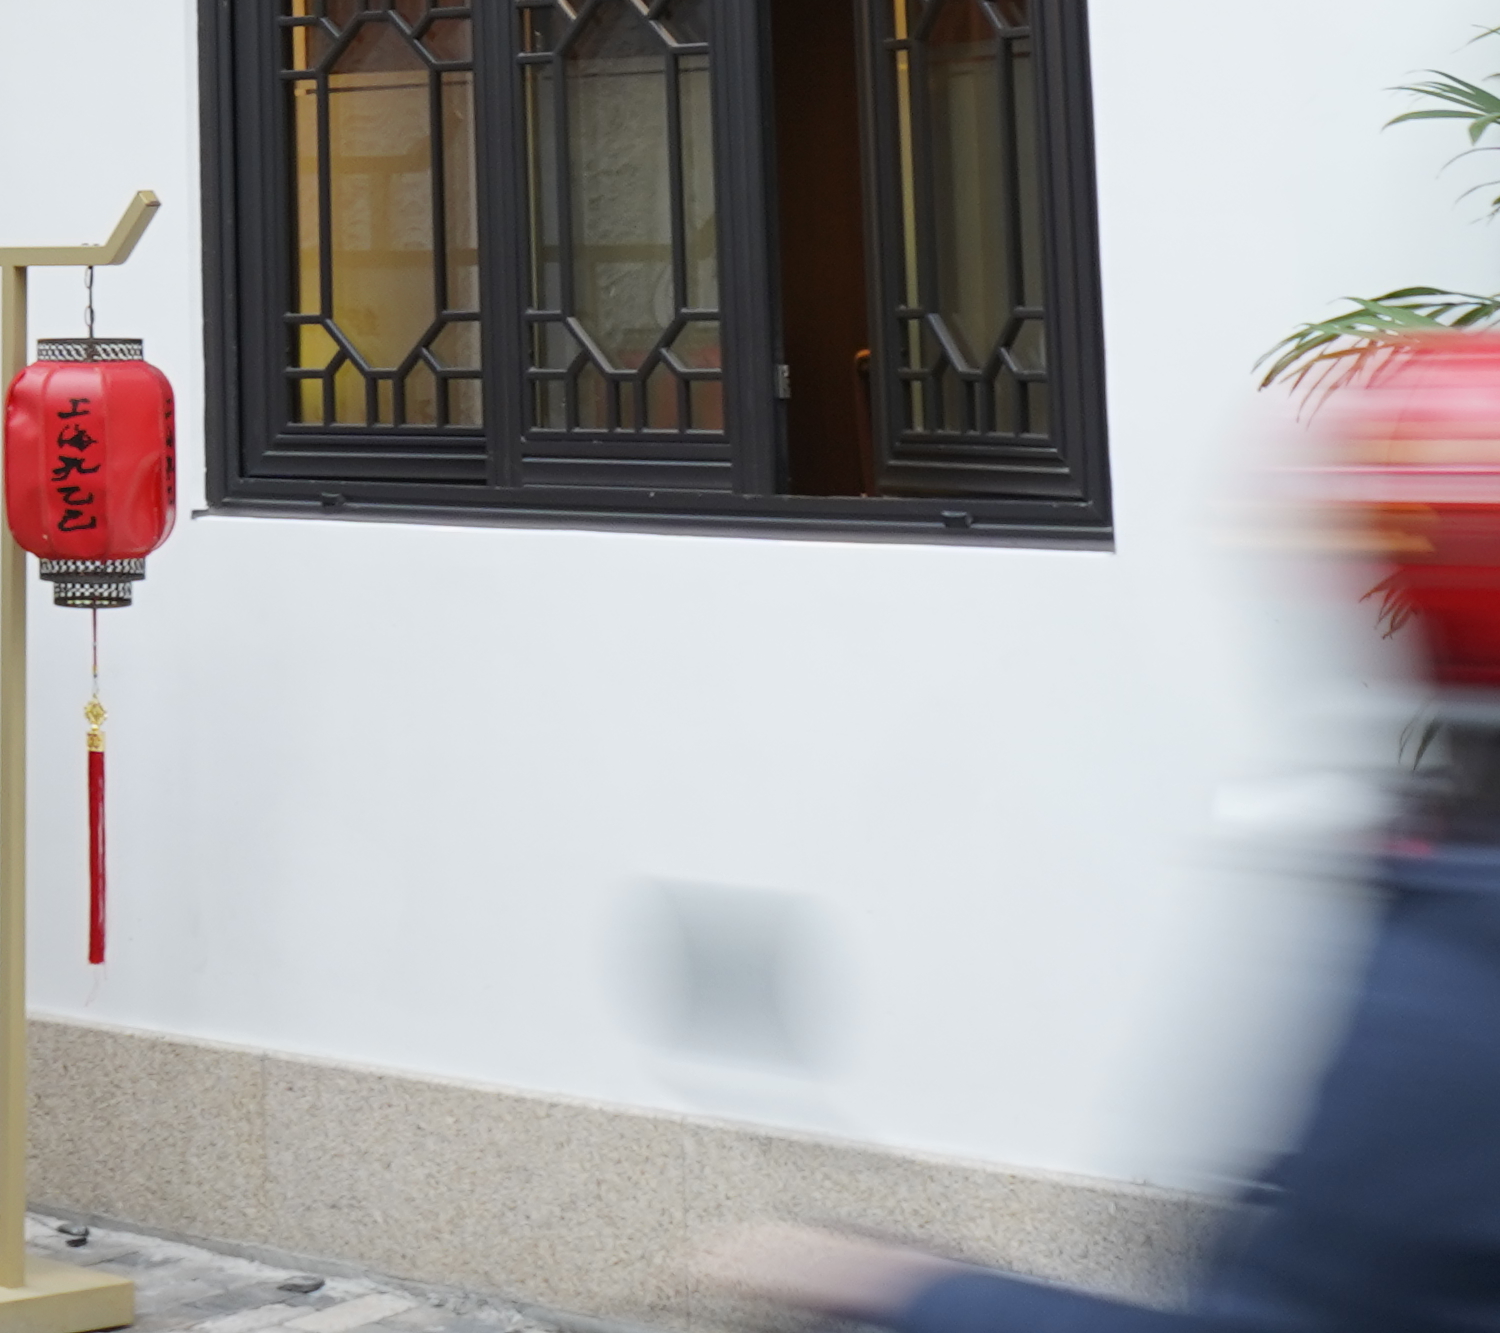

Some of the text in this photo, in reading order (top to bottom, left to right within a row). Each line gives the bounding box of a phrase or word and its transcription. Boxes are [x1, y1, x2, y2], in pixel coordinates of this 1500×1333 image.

[52, 398, 101, 533] 上海孔乙己
